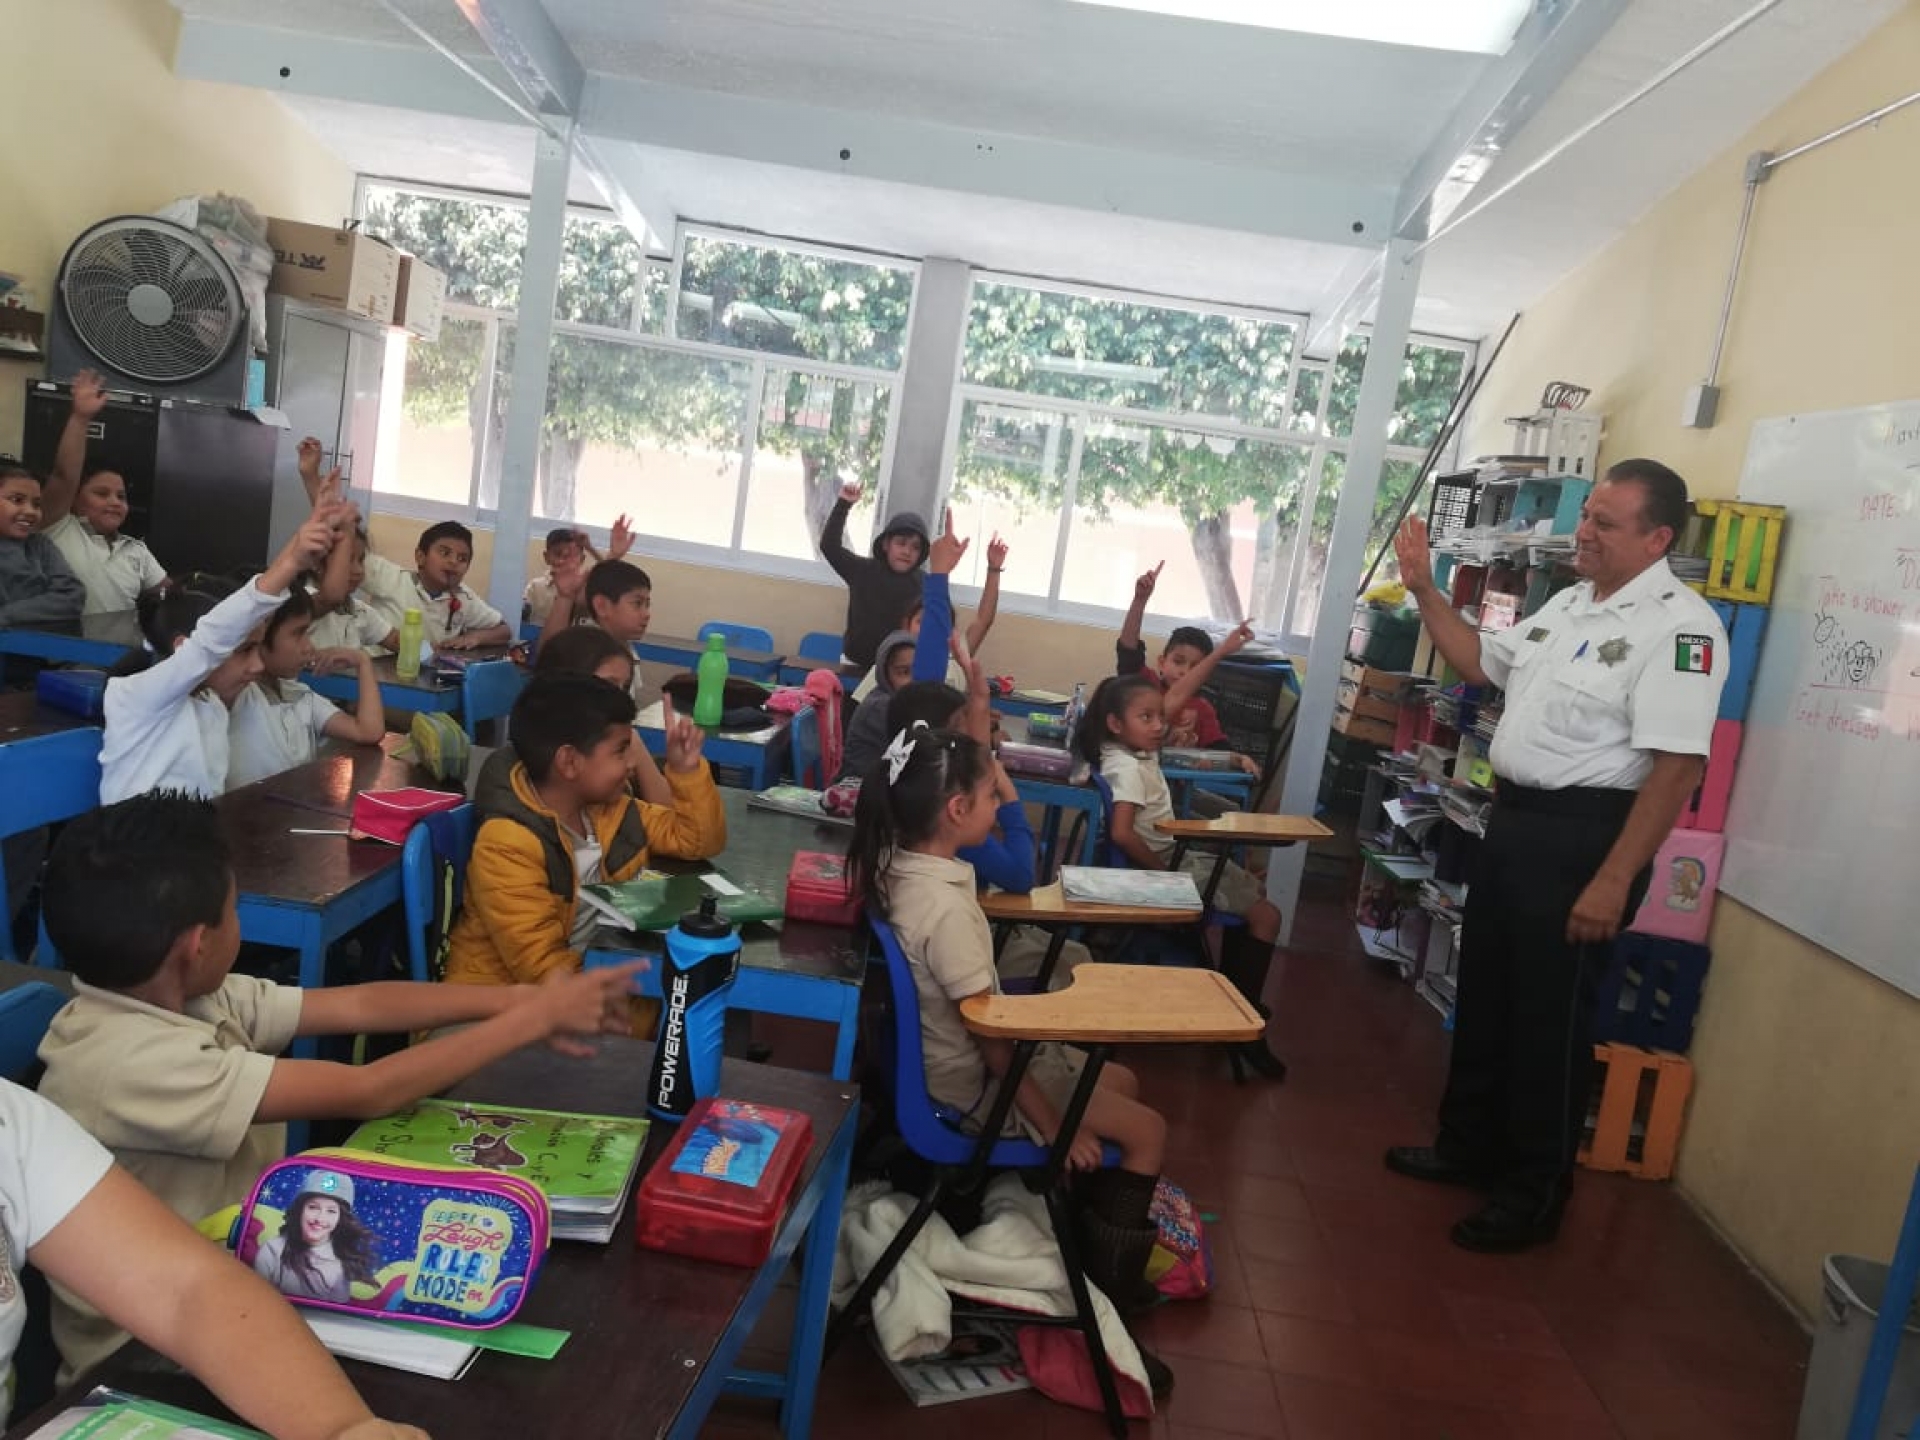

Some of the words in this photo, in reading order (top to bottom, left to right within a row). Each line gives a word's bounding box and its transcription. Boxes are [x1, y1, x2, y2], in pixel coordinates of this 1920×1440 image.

[658, 976, 688, 1109] POWERADE
[423, 1222, 505, 1252] Laugh
[423, 1244, 493, 1282] ROLLER
[413, 1274, 468, 1304] MODE
